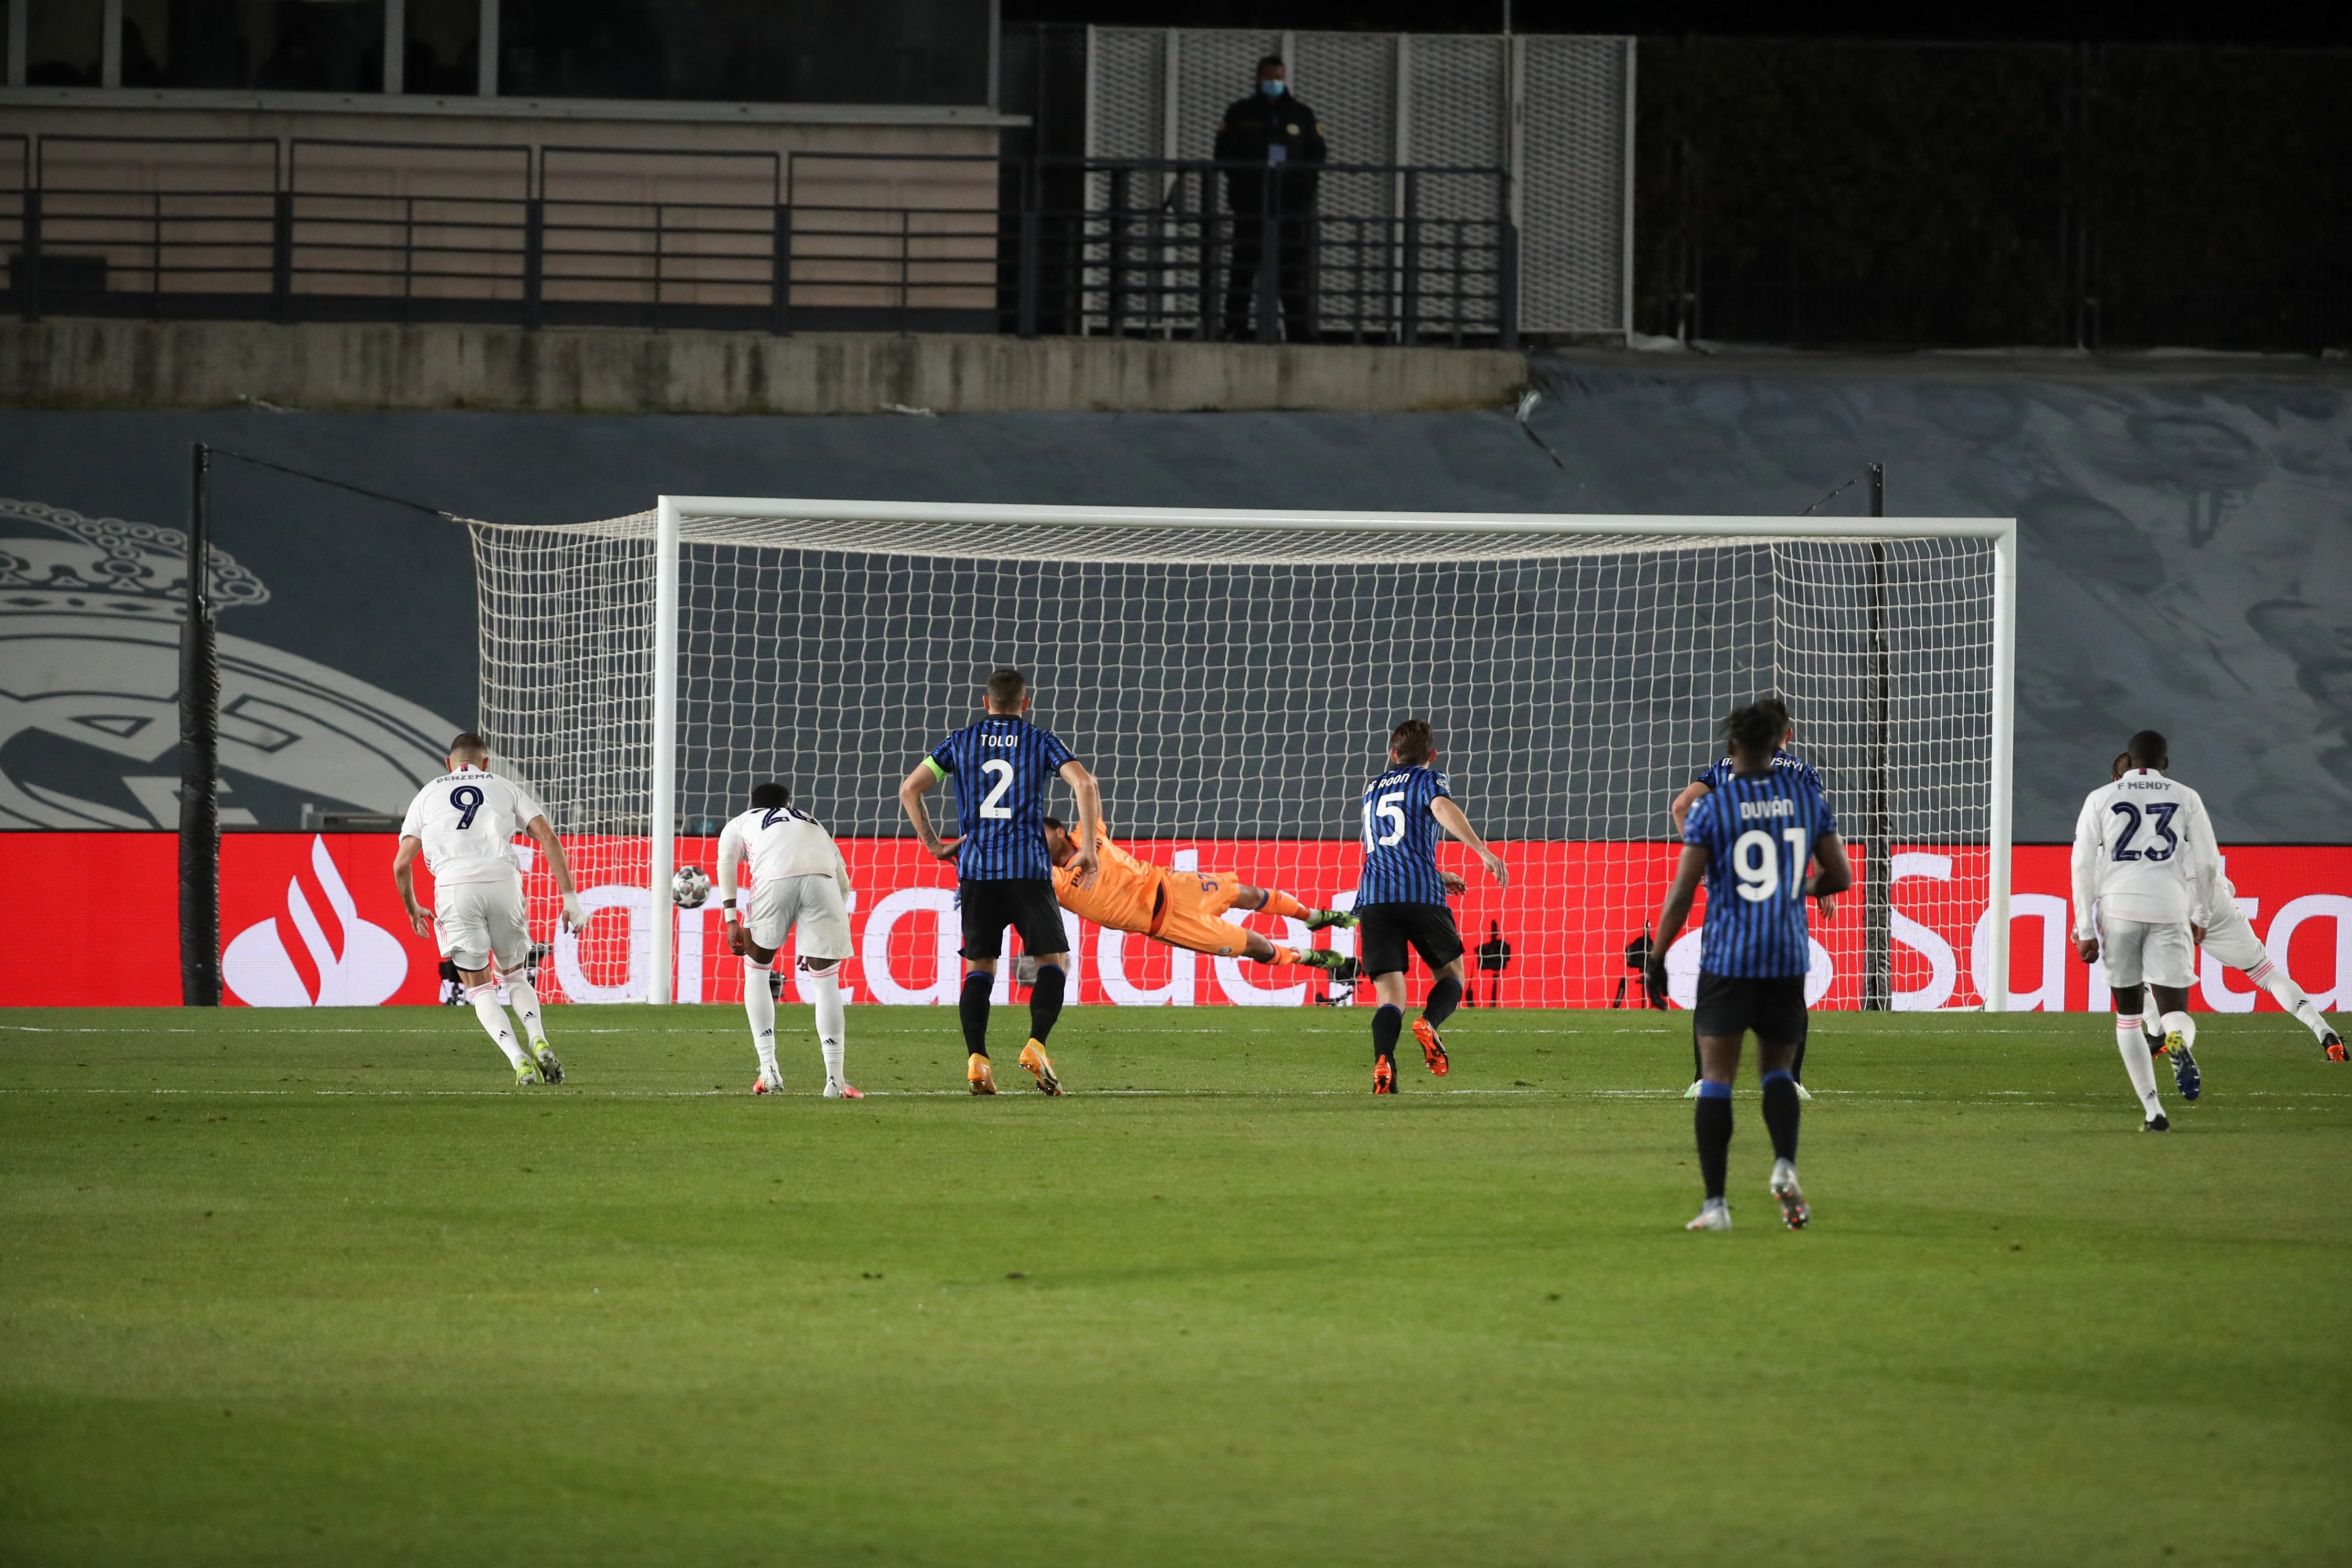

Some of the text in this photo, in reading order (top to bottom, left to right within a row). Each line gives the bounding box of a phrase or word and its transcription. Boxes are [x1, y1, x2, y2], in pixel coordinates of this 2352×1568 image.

[981, 734, 1018, 747] TOLOI
[437, 773, 494, 783] BENZEMA
[980, 759, 1014, 818] 2
[1377, 773, 1410, 789] ROON
[2128, 782, 2171, 790] MENDY
[449, 786, 484, 829] 9
[1363, 791, 1406, 854] 15
[2111, 801, 2180, 862] 23
[1733, 827, 1806, 902] 91
